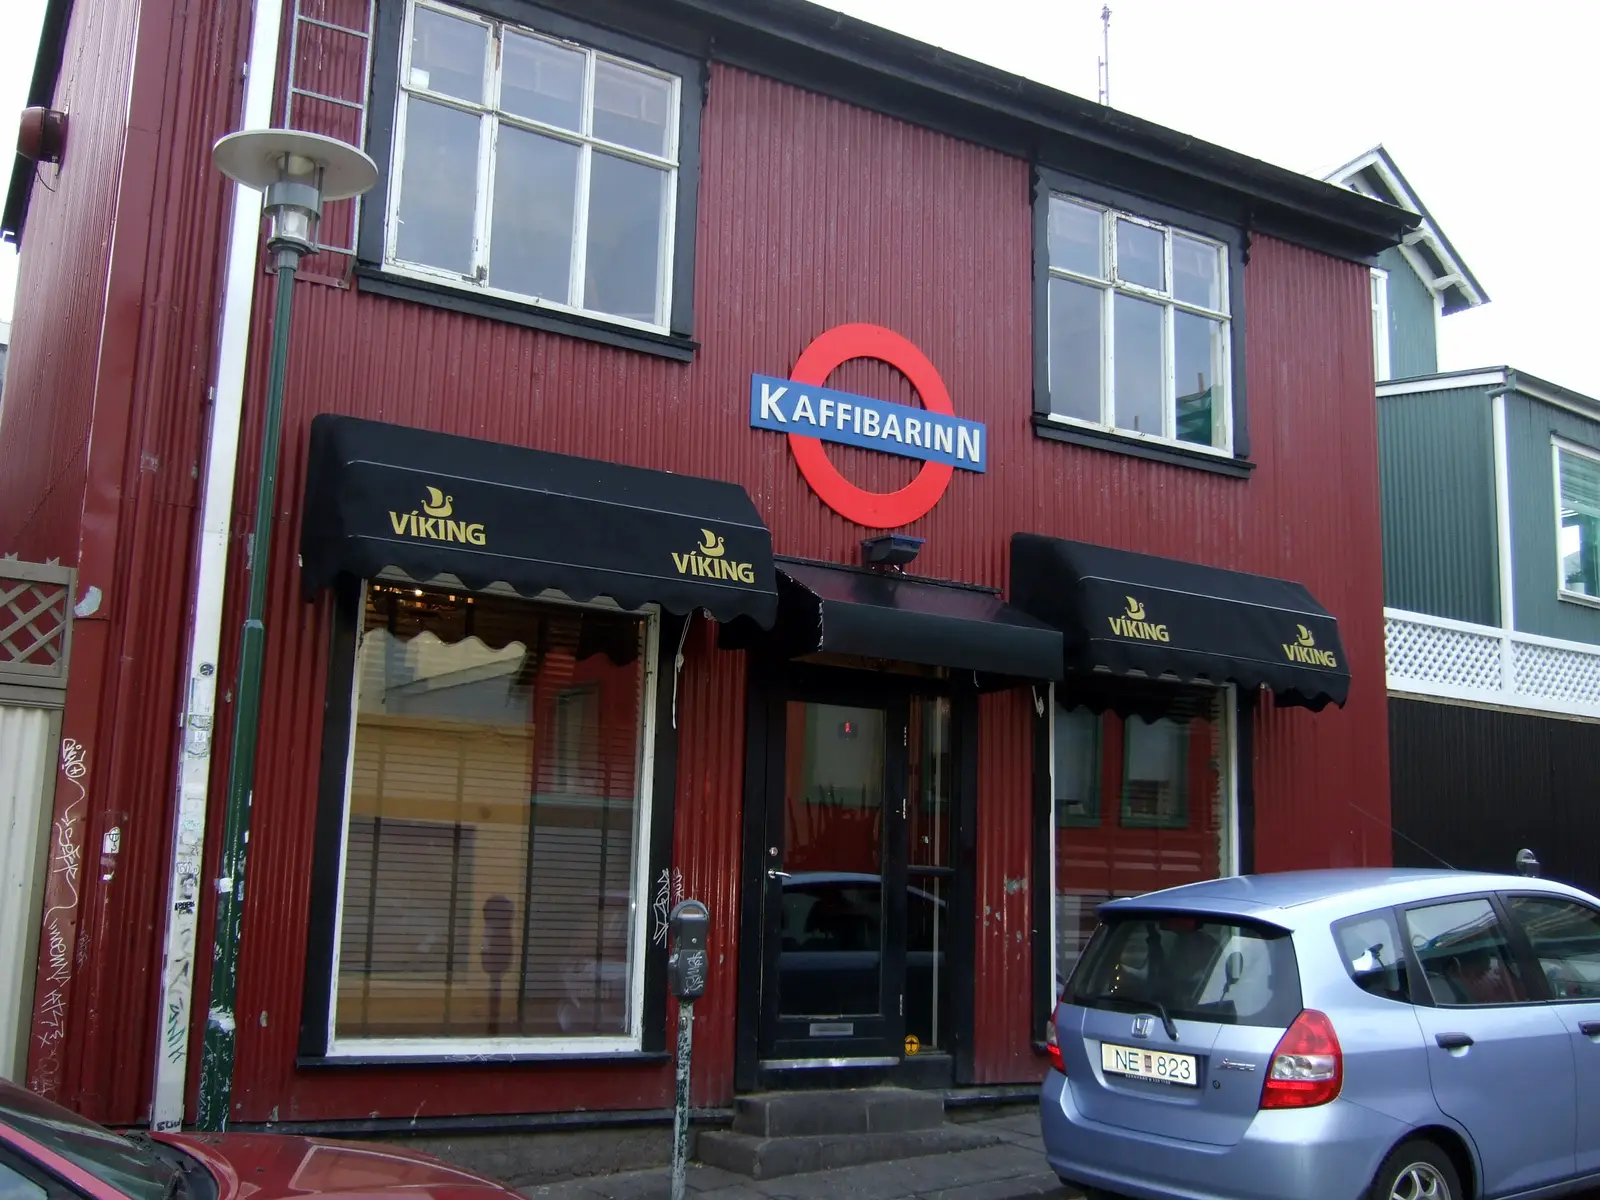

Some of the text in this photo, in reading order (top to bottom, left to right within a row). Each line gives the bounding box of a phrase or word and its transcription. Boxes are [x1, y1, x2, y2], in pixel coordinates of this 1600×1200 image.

[760, 384, 980, 462] KAFFIBARINN
[389, 510, 486, 545] VÍKING
[671, 550, 755, 584] VÍKING
[1108, 615, 1170, 642] VÍKING
[1283, 642, 1337, 668] VÍKING
[1115, 1049, 1139, 1072] NE
[1157, 1056, 1191, 1080] 823
